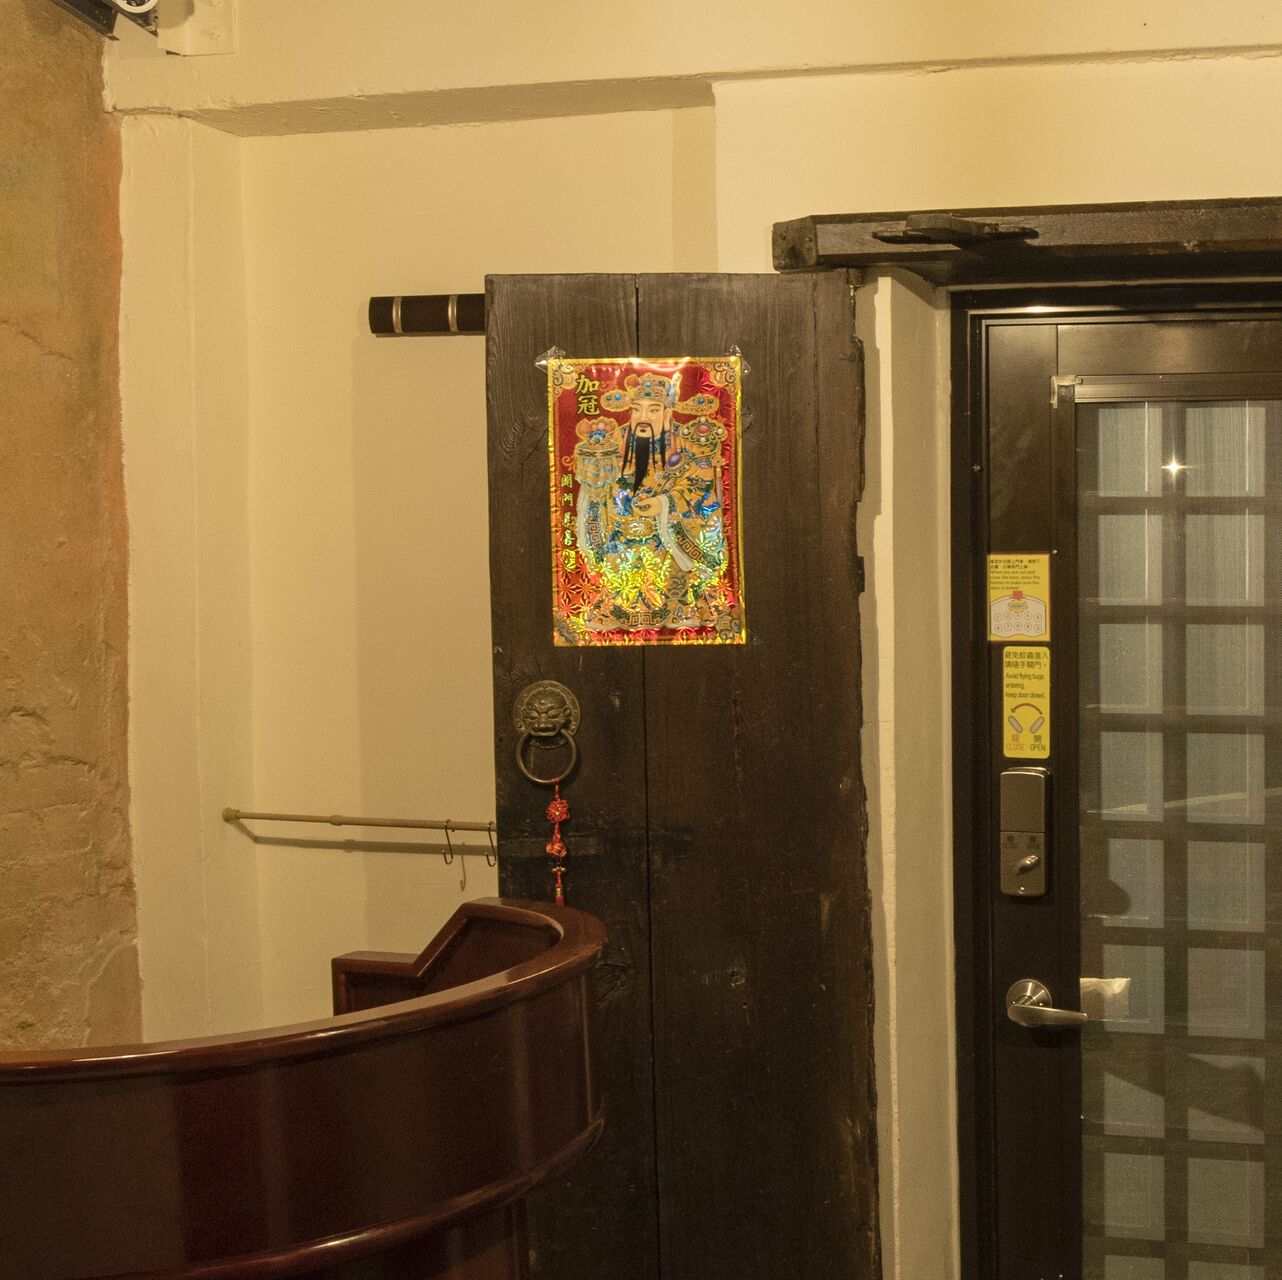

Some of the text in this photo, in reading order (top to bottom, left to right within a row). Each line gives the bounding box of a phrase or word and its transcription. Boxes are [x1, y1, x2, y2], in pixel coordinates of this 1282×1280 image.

[575, 374, 601, 415] 加冠
[1006, 743, 1025, 751] CLOSE
[1029, 743, 1046, 751] OPEN
